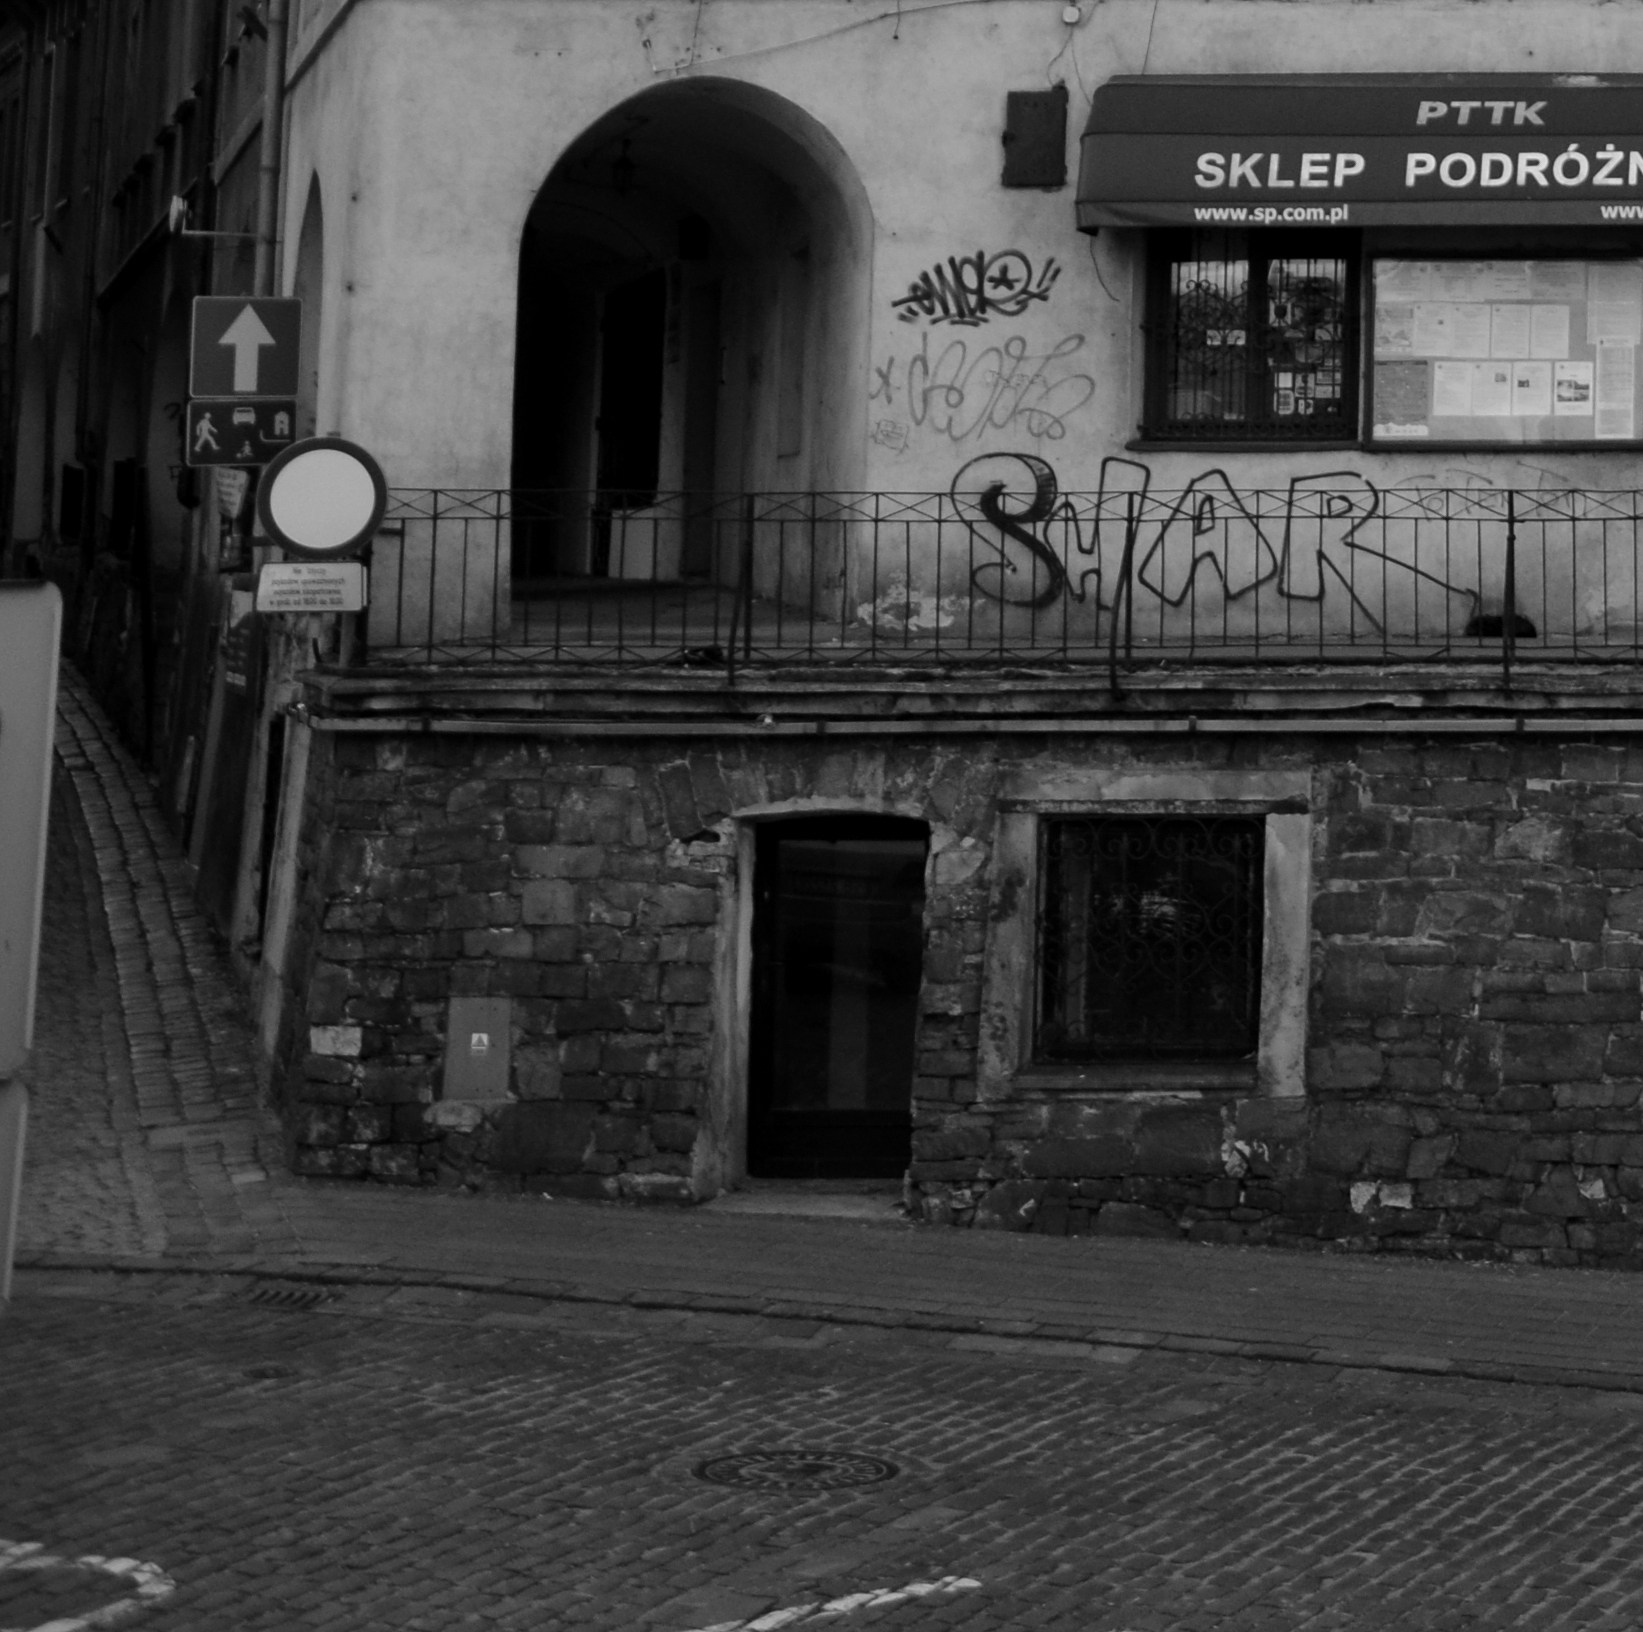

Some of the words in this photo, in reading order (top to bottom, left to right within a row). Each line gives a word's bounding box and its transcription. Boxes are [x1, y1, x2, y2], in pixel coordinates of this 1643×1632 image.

[1416, 100, 1547, 126] PTTK
[1194, 151, 1366, 188] SKLEP
[1194, 203, 1349, 224] www.sp.com.pl
